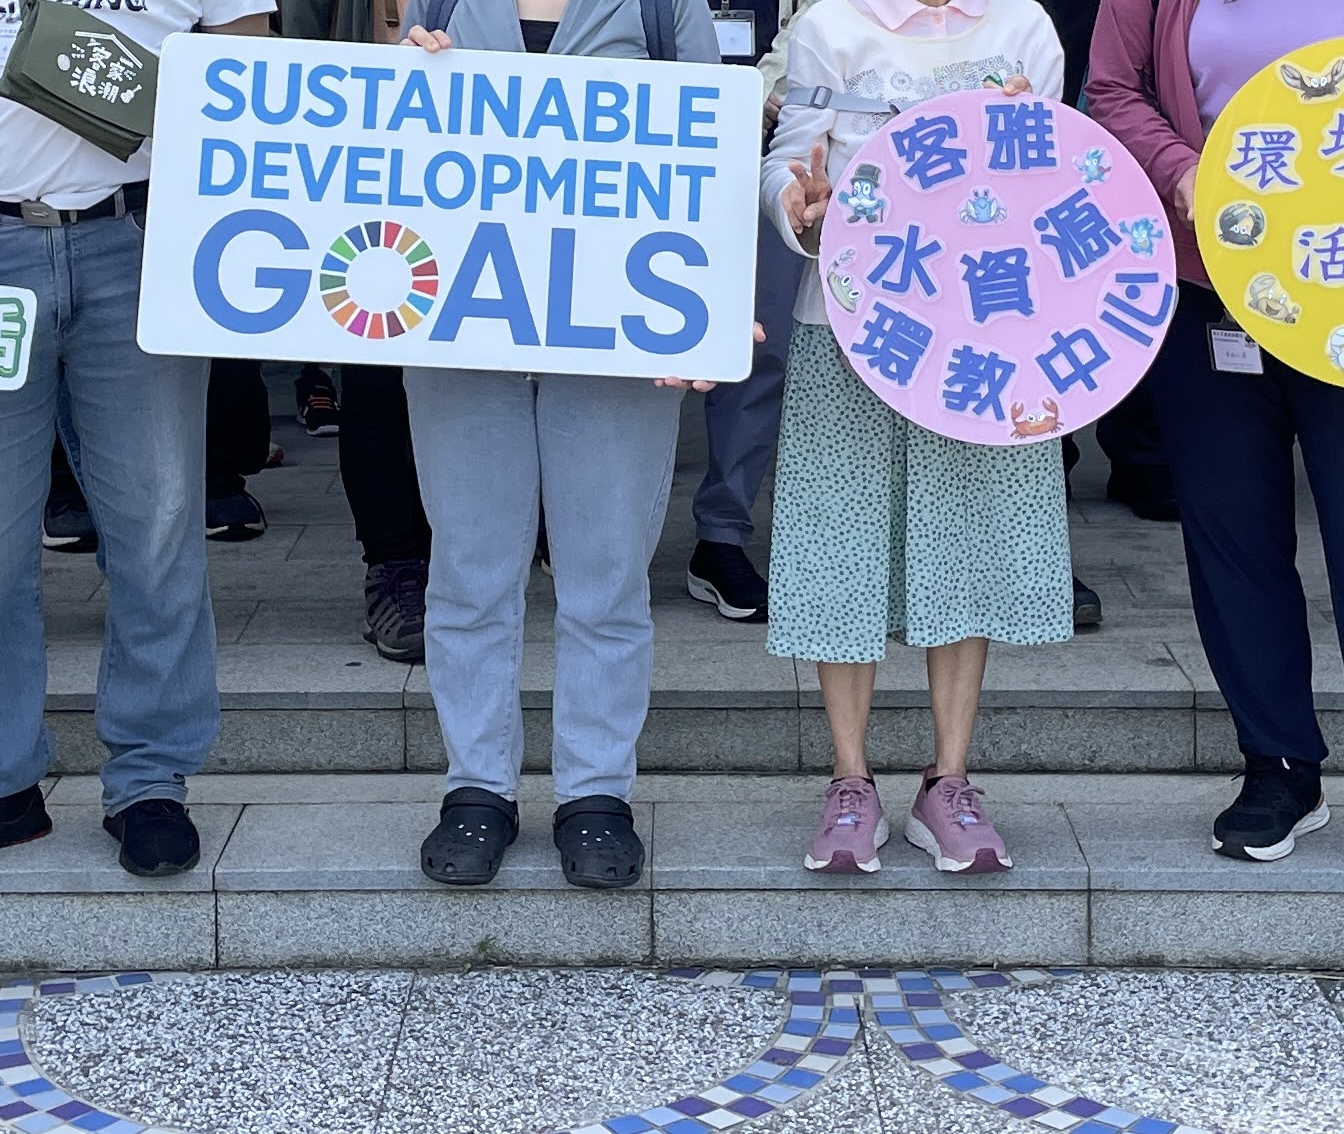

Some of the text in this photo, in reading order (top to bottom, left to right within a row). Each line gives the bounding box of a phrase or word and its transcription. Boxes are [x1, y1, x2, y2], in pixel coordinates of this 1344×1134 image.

[199, 57, 721, 149] SUSTAINABLE
[890, 101, 1058, 191] 客雅
[197, 137, 717, 223] DEVELOPMENT
[192, 208, 710, 356] GOALS
[866, 187, 1124, 325] 水資源
[850, 271, 1175, 422] 環教中心
